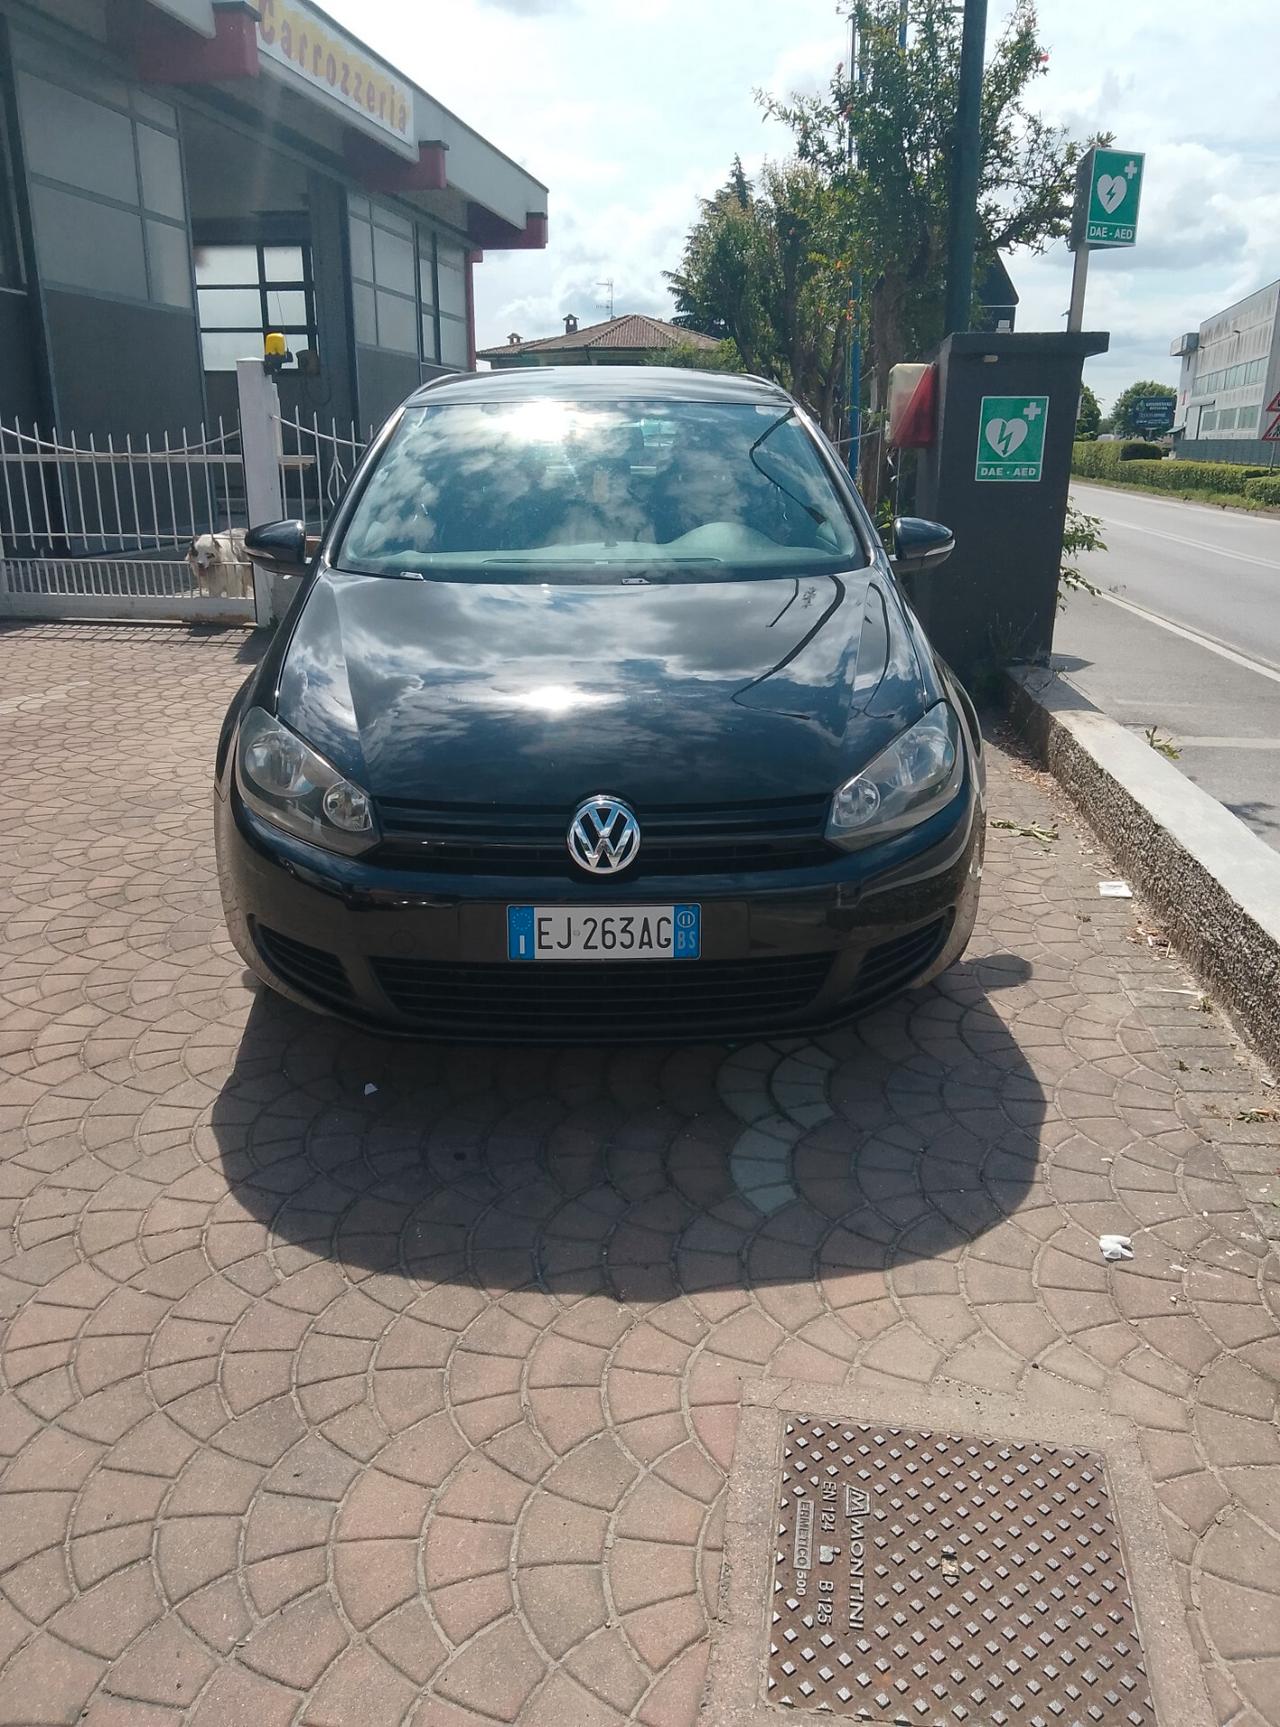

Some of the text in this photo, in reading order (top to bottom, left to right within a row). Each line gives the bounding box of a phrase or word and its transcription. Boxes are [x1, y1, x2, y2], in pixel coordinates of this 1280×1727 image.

[1089, 226, 1108, 238] DAE
[1114, 228, 1133, 240] AED
[980, 467, 1004, 476] DAE
[1012, 467, 1037, 476] AED
[571, 802, 637, 871] VW
[537, 916, 672, 950] EJ 263AG
[677, 931, 696, 949] BS
[820, 1480, 837, 1533] EN 124
[795, 1500, 812, 1596] ERMETICO 500
[848, 1517, 865, 1631] MONTINI
[817, 1580, 834, 1626] B 125
